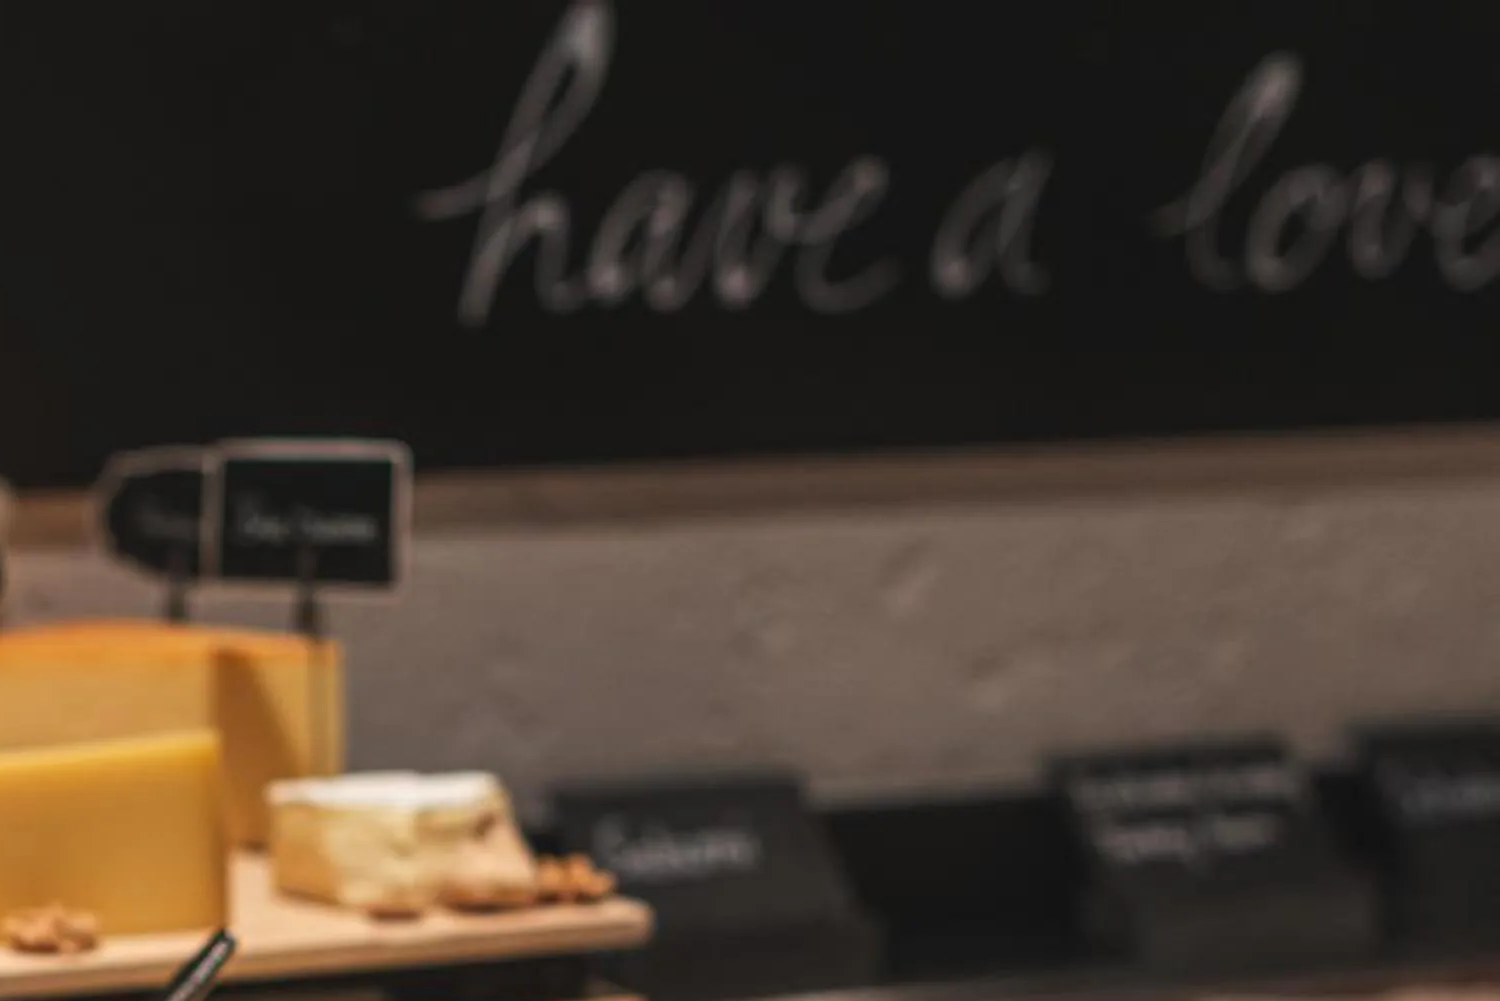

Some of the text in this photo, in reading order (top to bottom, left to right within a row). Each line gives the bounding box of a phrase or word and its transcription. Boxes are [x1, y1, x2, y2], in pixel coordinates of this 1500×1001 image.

[418, 0, 1500, 326] have a love
